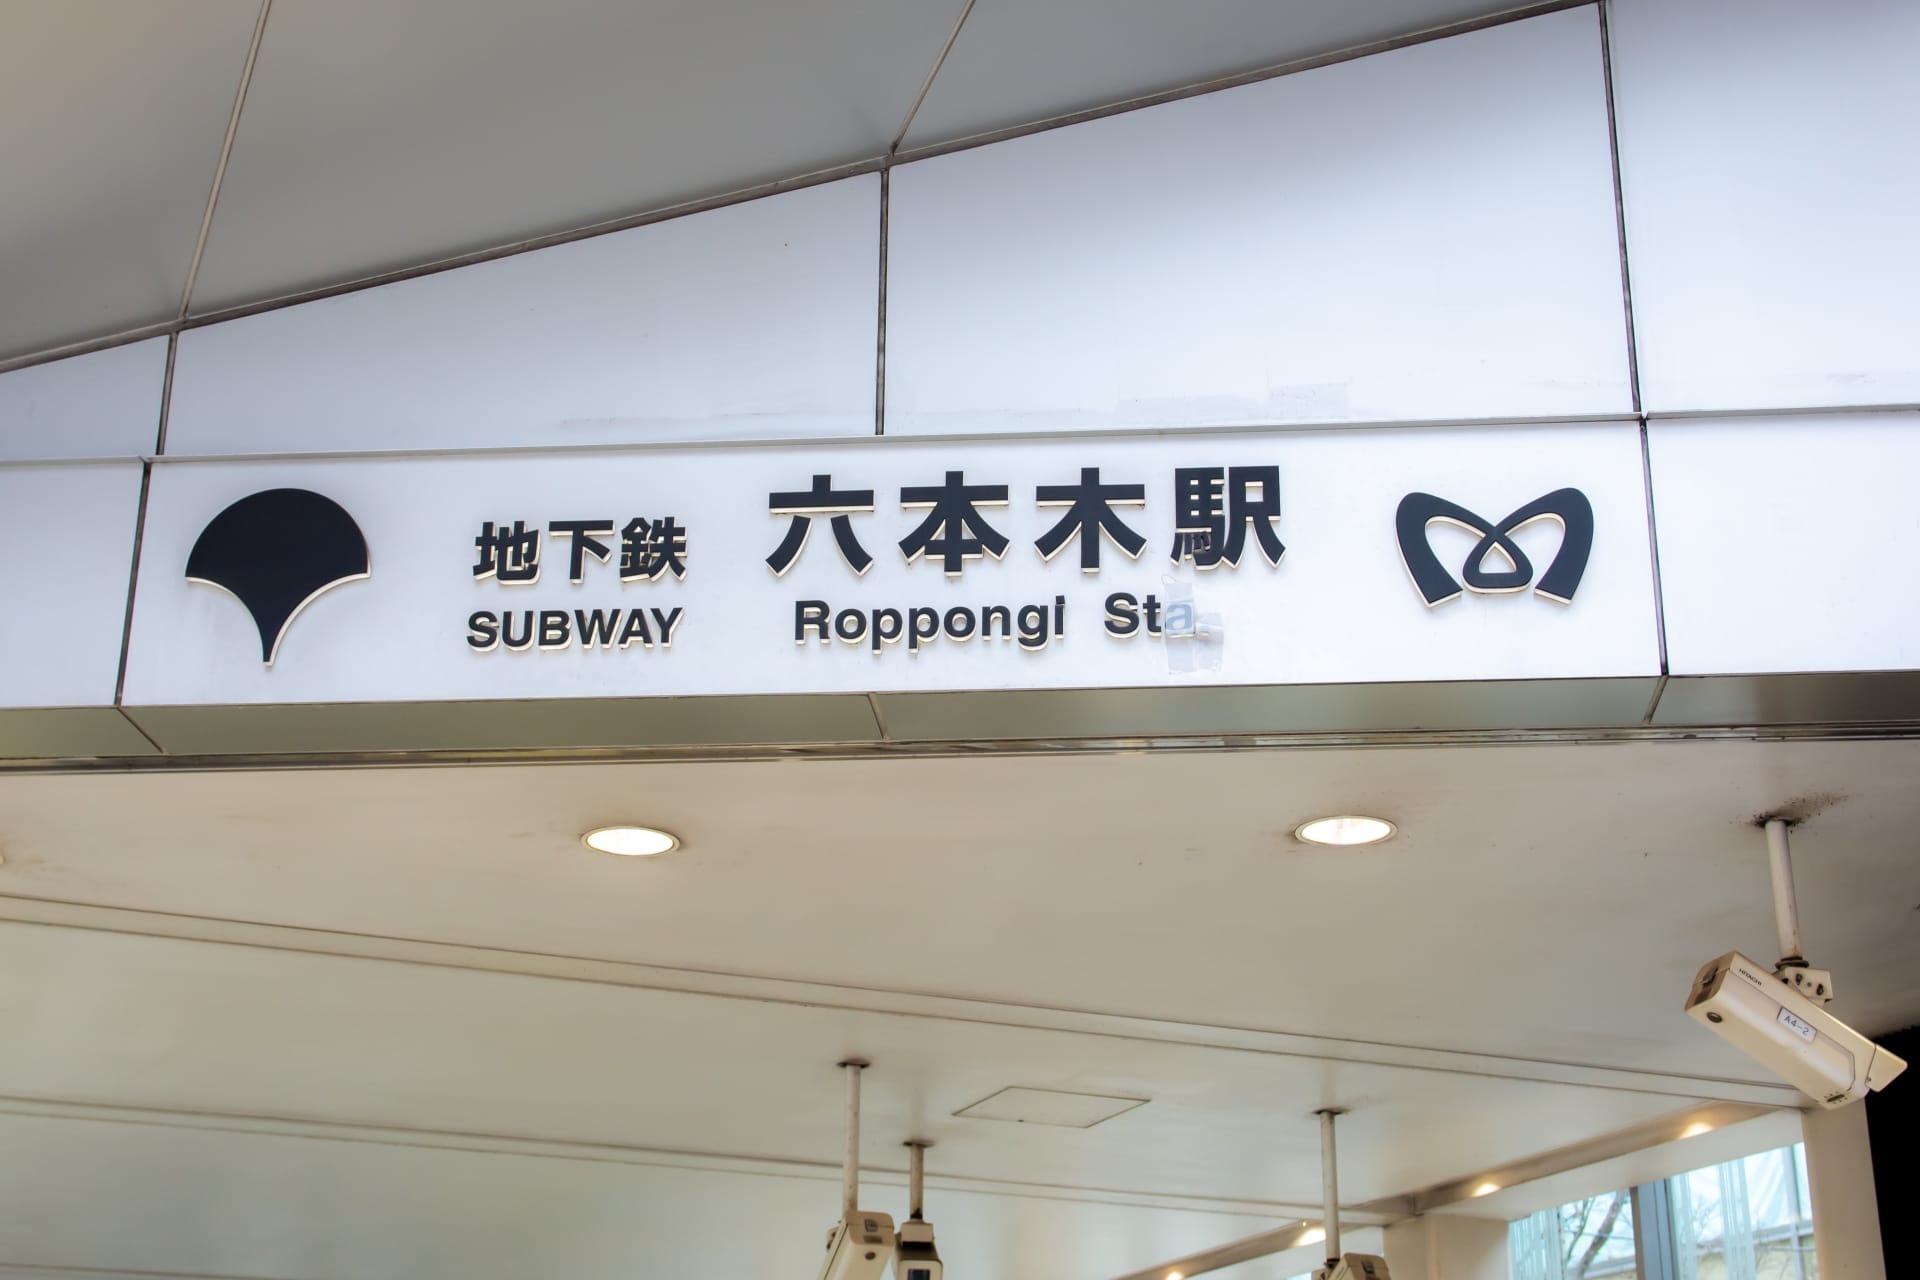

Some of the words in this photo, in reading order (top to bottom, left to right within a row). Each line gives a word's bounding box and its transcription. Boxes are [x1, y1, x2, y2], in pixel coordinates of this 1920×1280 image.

[766, 466, 1286, 576] 六本木駅
[473, 517, 688, 583] 地下鉄
[467, 608, 683, 650] SUBWAY
[795, 595, 1065, 654] Roppongi
[1104, 592, 1193, 637] Sta
[1738, 967, 1763, 987] HITACHI
[1783, 1015, 1810, 1037] A4-2
